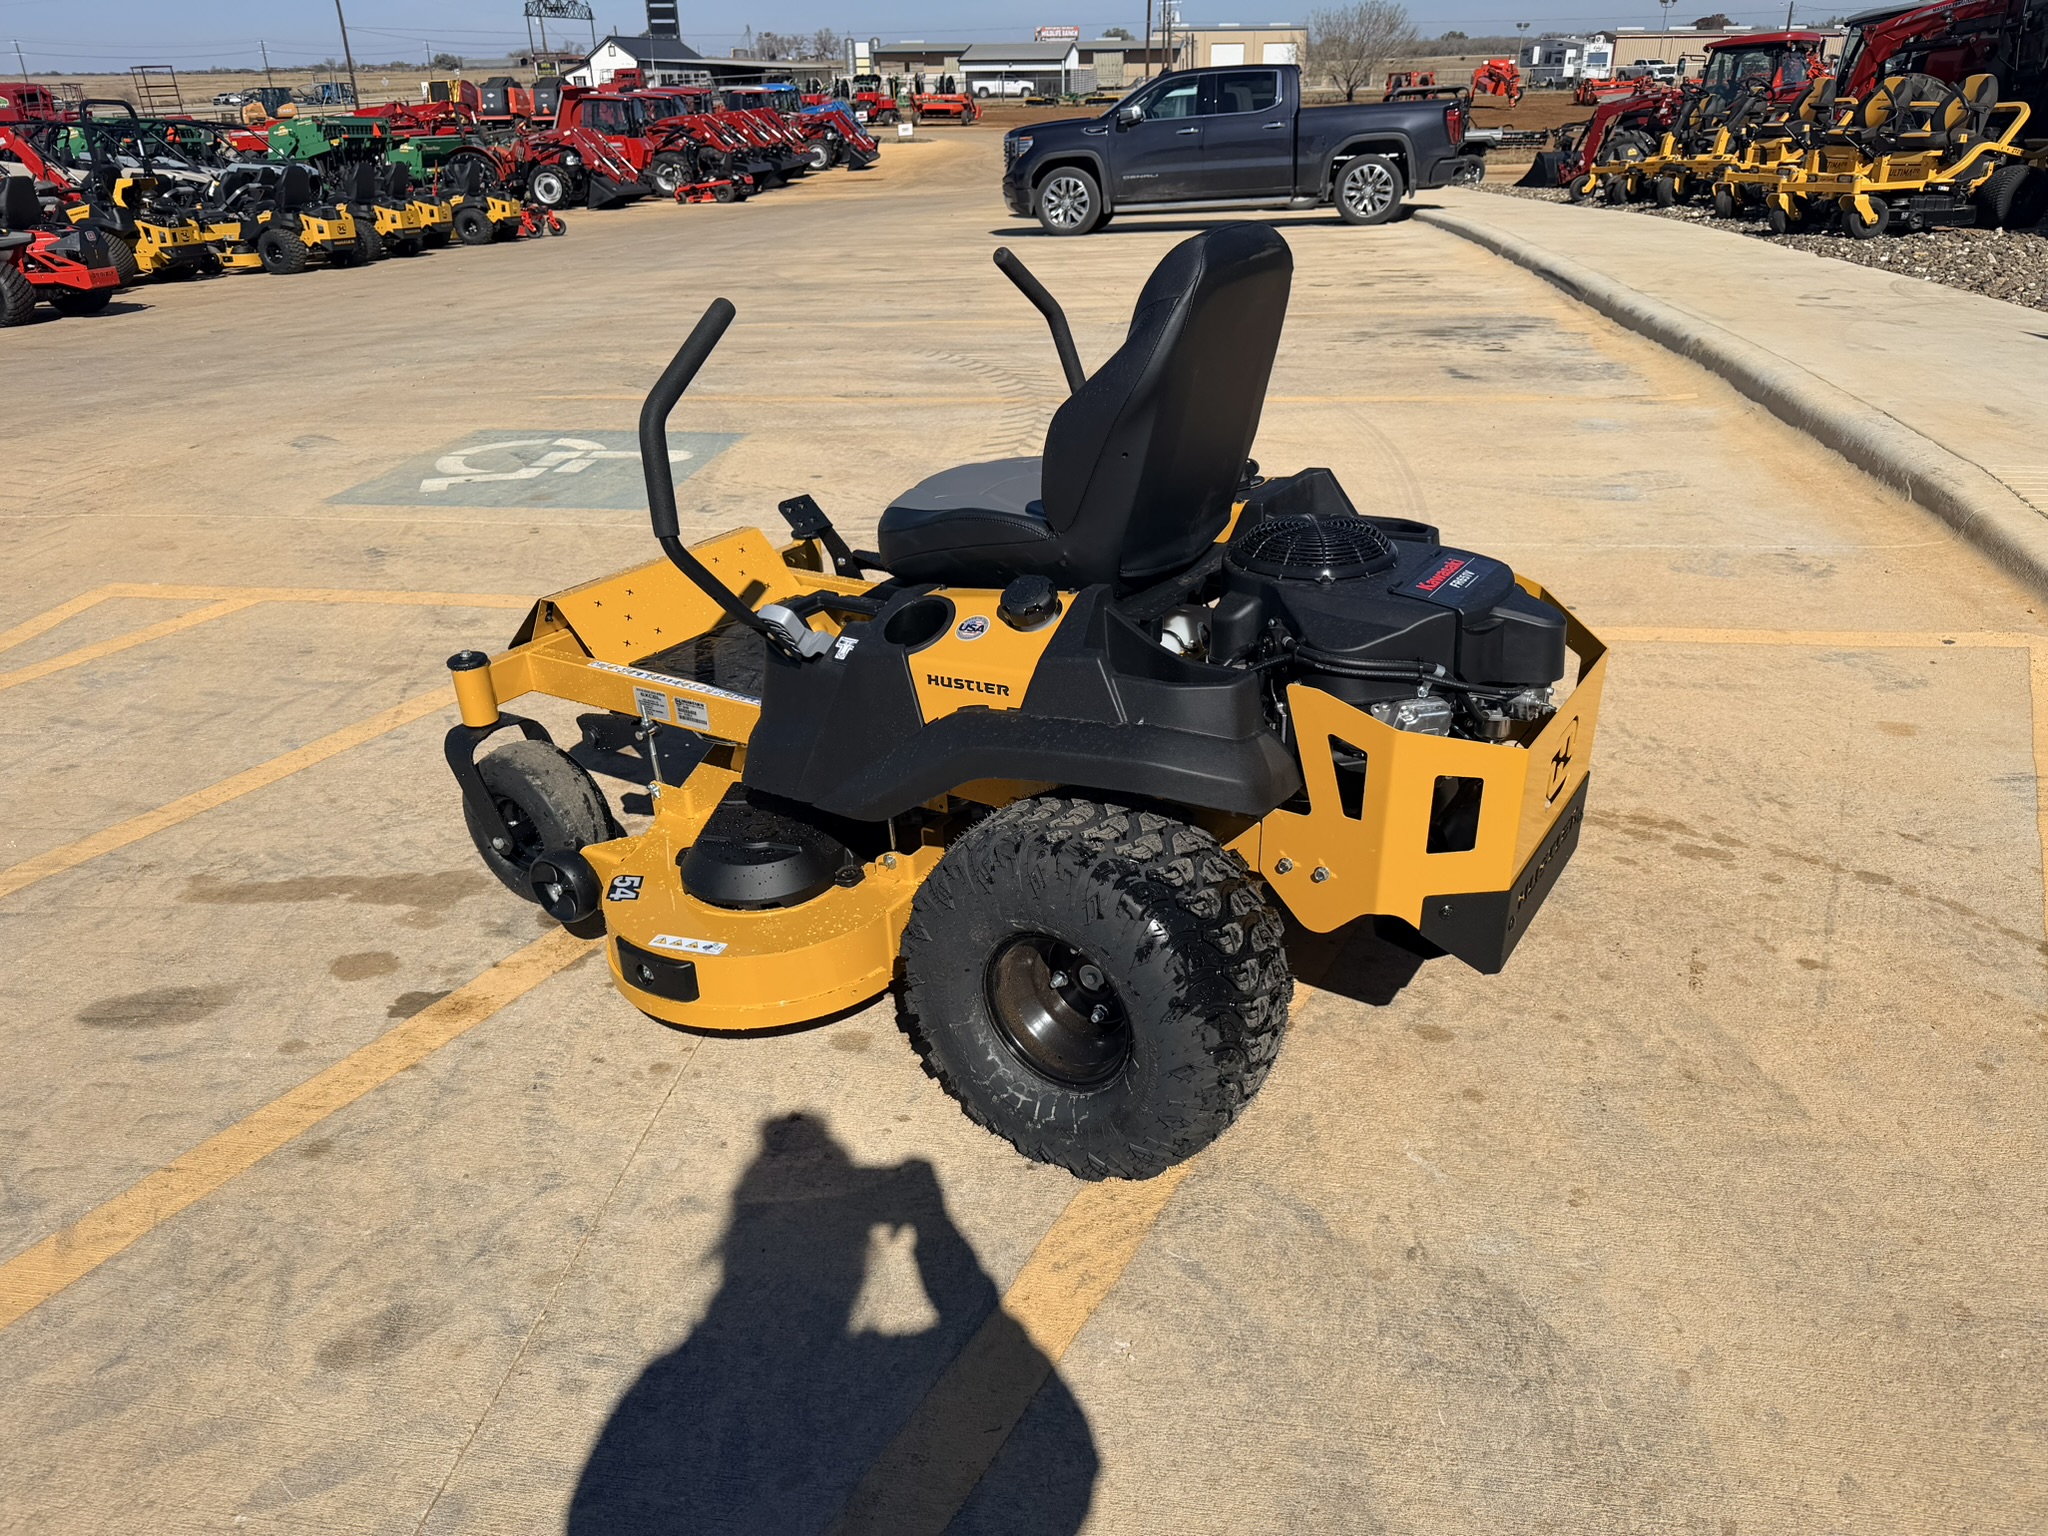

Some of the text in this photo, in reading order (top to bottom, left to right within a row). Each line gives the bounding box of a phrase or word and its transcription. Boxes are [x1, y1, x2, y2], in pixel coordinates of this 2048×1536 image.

[1415, 557, 1466, 591] Kawasaki
[958, 622, 985, 633] USA
[926, 673, 1010, 697] HUSTLER
[608, 876, 642, 901] 54
